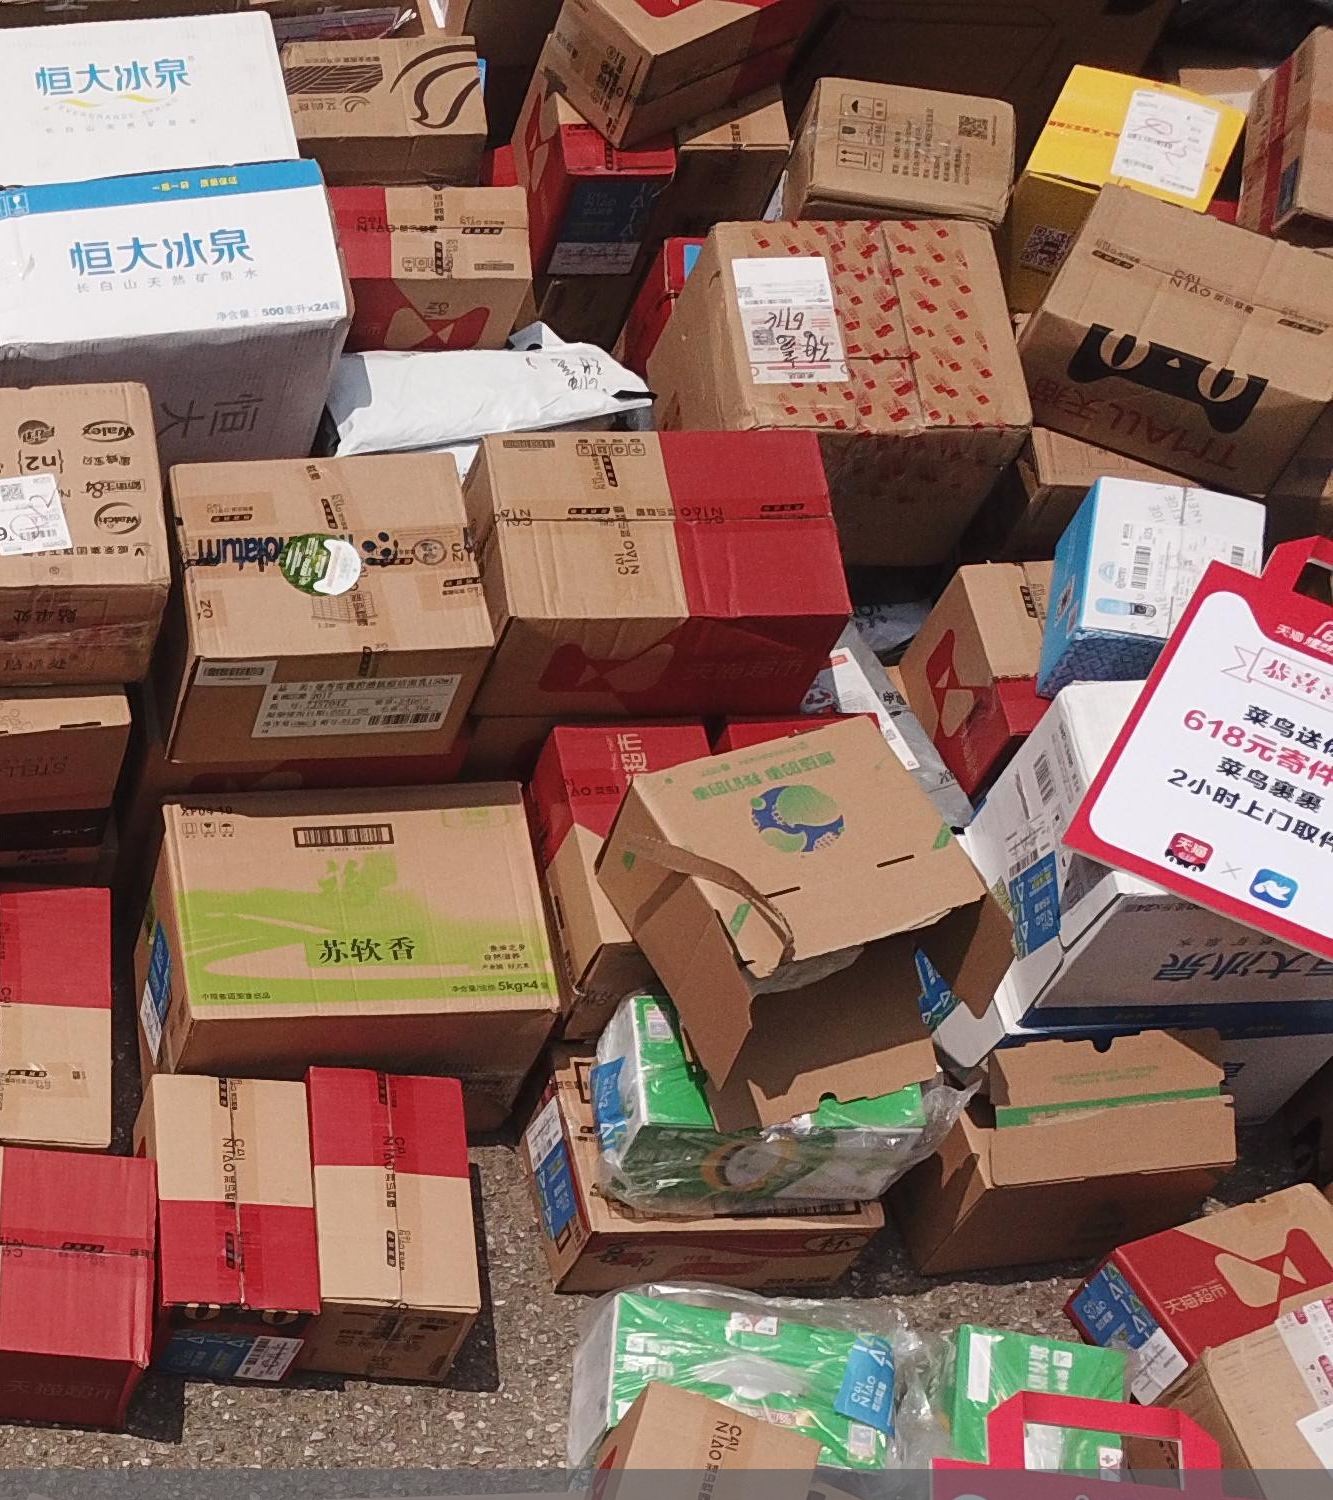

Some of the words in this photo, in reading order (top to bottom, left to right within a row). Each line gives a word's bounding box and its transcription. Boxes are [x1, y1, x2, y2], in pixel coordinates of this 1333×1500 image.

[34, 57, 192, 97] 恒大冰泉
[70, 228, 255, 277] 恒大冰泉
[74, 267, 260, 295] 长白山天然矿泉水
[1216, 757, 1325, 813] 菜鸟裹裹
[318, 936, 417, 965] 苏软香
[1162, 1282, 1227, 1315] 天猫超市
